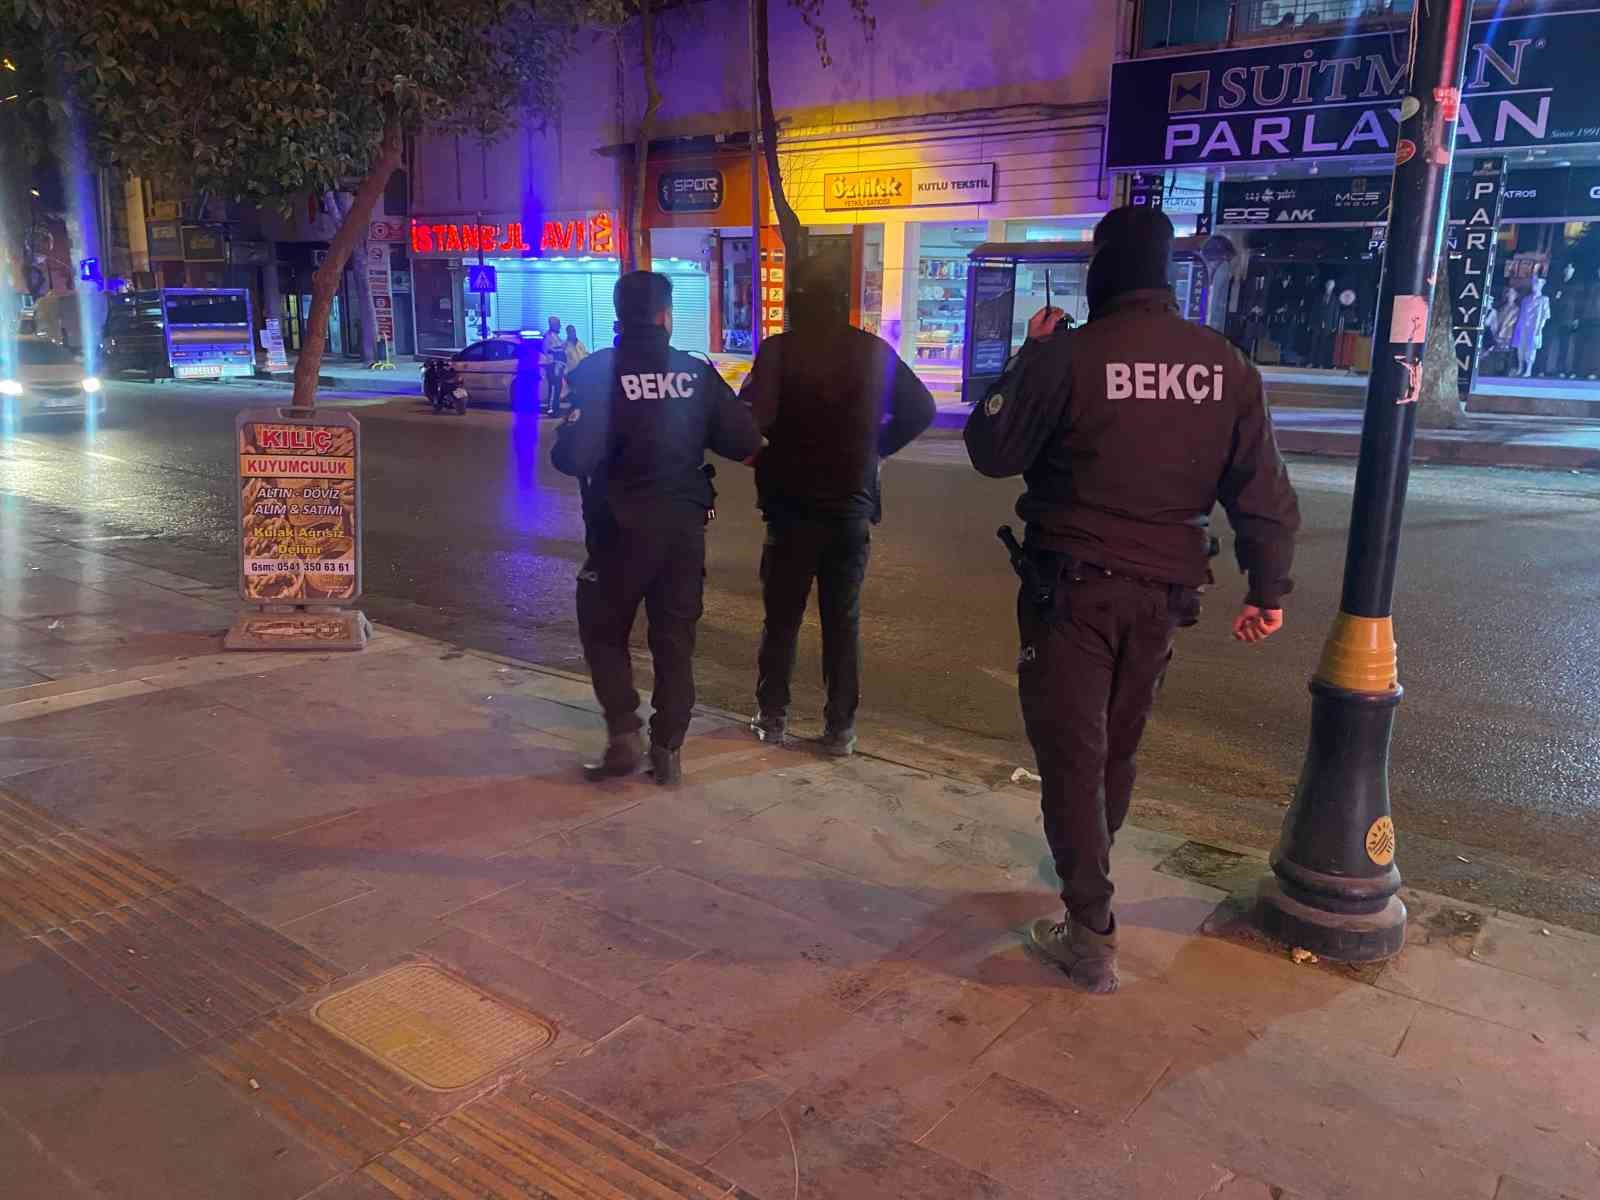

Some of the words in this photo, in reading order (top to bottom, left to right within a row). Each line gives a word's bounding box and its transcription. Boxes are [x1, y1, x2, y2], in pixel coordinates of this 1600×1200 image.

[1218, 38, 1532, 110] SUİTMN
[1164, 97, 1550, 161] PARLAAN
[673, 177, 718, 192] SPOR
[918, 182, 948, 192] KUTLU
[951, 178, 990, 190] TEKSTİL
[262, 429, 332, 453] KILIÇ
[247, 459, 347, 474] KUYUMCULUK
[257, 488, 293, 498] ALTIN
[303, 487, 341, 499] DÖVİZ
[255, 504, 287, 514] ALIM
[290, 505, 299, 514] &
[254, 527, 294, 537] Kulak
[251, 562, 274, 572] Gsm:
[277, 563, 300, 571] 0541
[303, 563, 321, 571] 350
